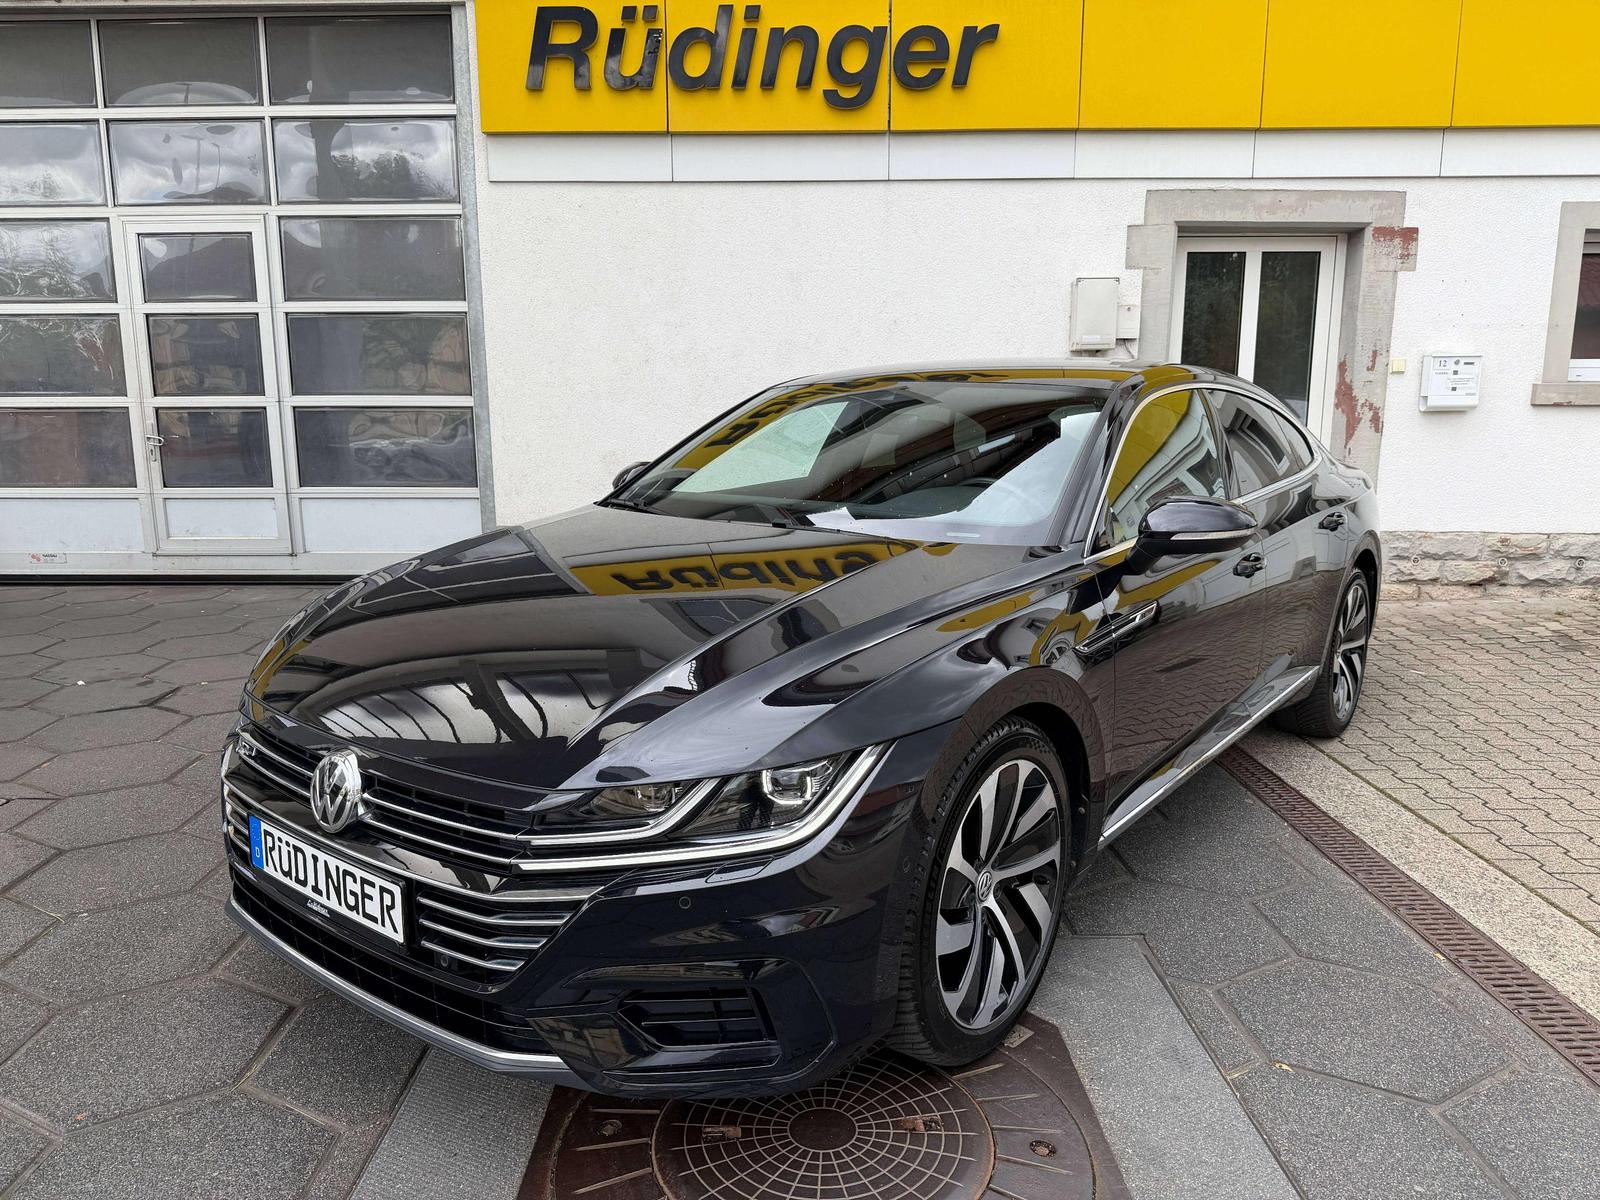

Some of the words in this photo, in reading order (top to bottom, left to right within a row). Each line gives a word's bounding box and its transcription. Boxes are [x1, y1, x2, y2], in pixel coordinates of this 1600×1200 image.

[525, 4, 1000, 110] Rüdinger
[1438, 359, 1448, 367] 12
[255, 846, 260, 858] D
